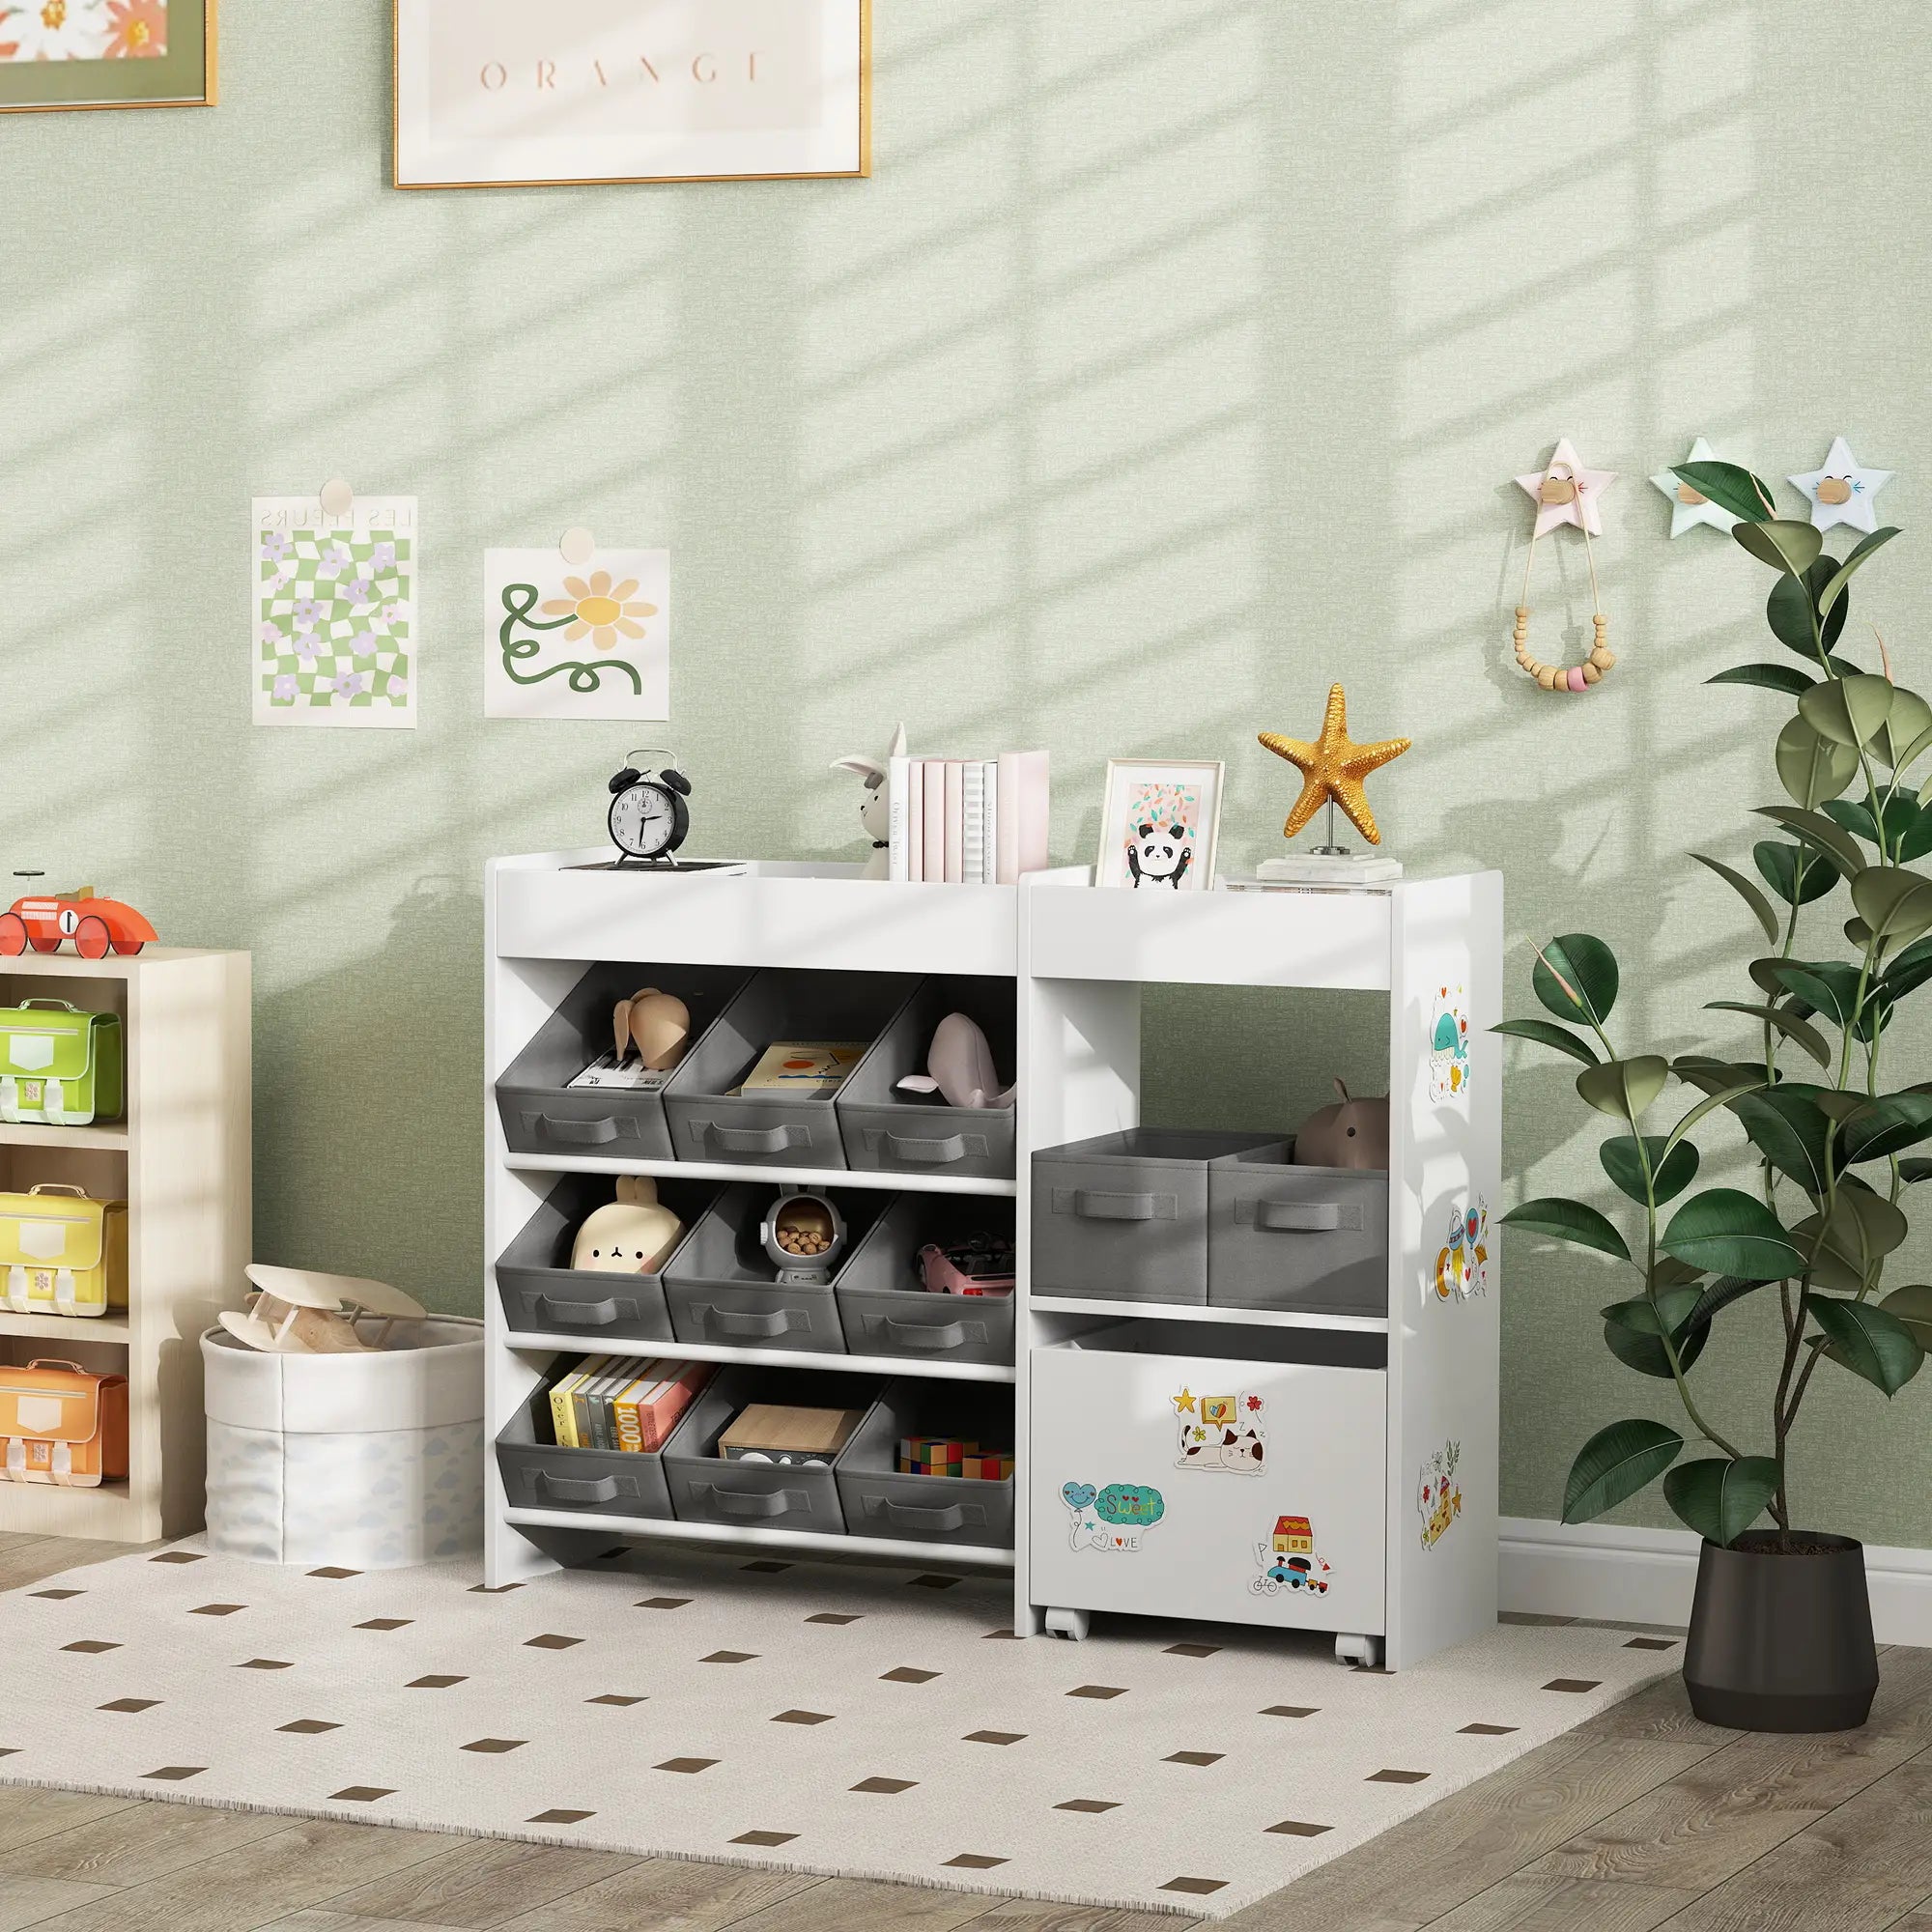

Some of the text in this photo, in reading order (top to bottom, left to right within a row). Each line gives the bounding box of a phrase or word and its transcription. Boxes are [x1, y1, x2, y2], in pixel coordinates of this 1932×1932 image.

[619, 828, 625, 837] 8
[617, 1406, 641, 1444] 1000
[1106, 1494, 1156, 1516] Sweet
